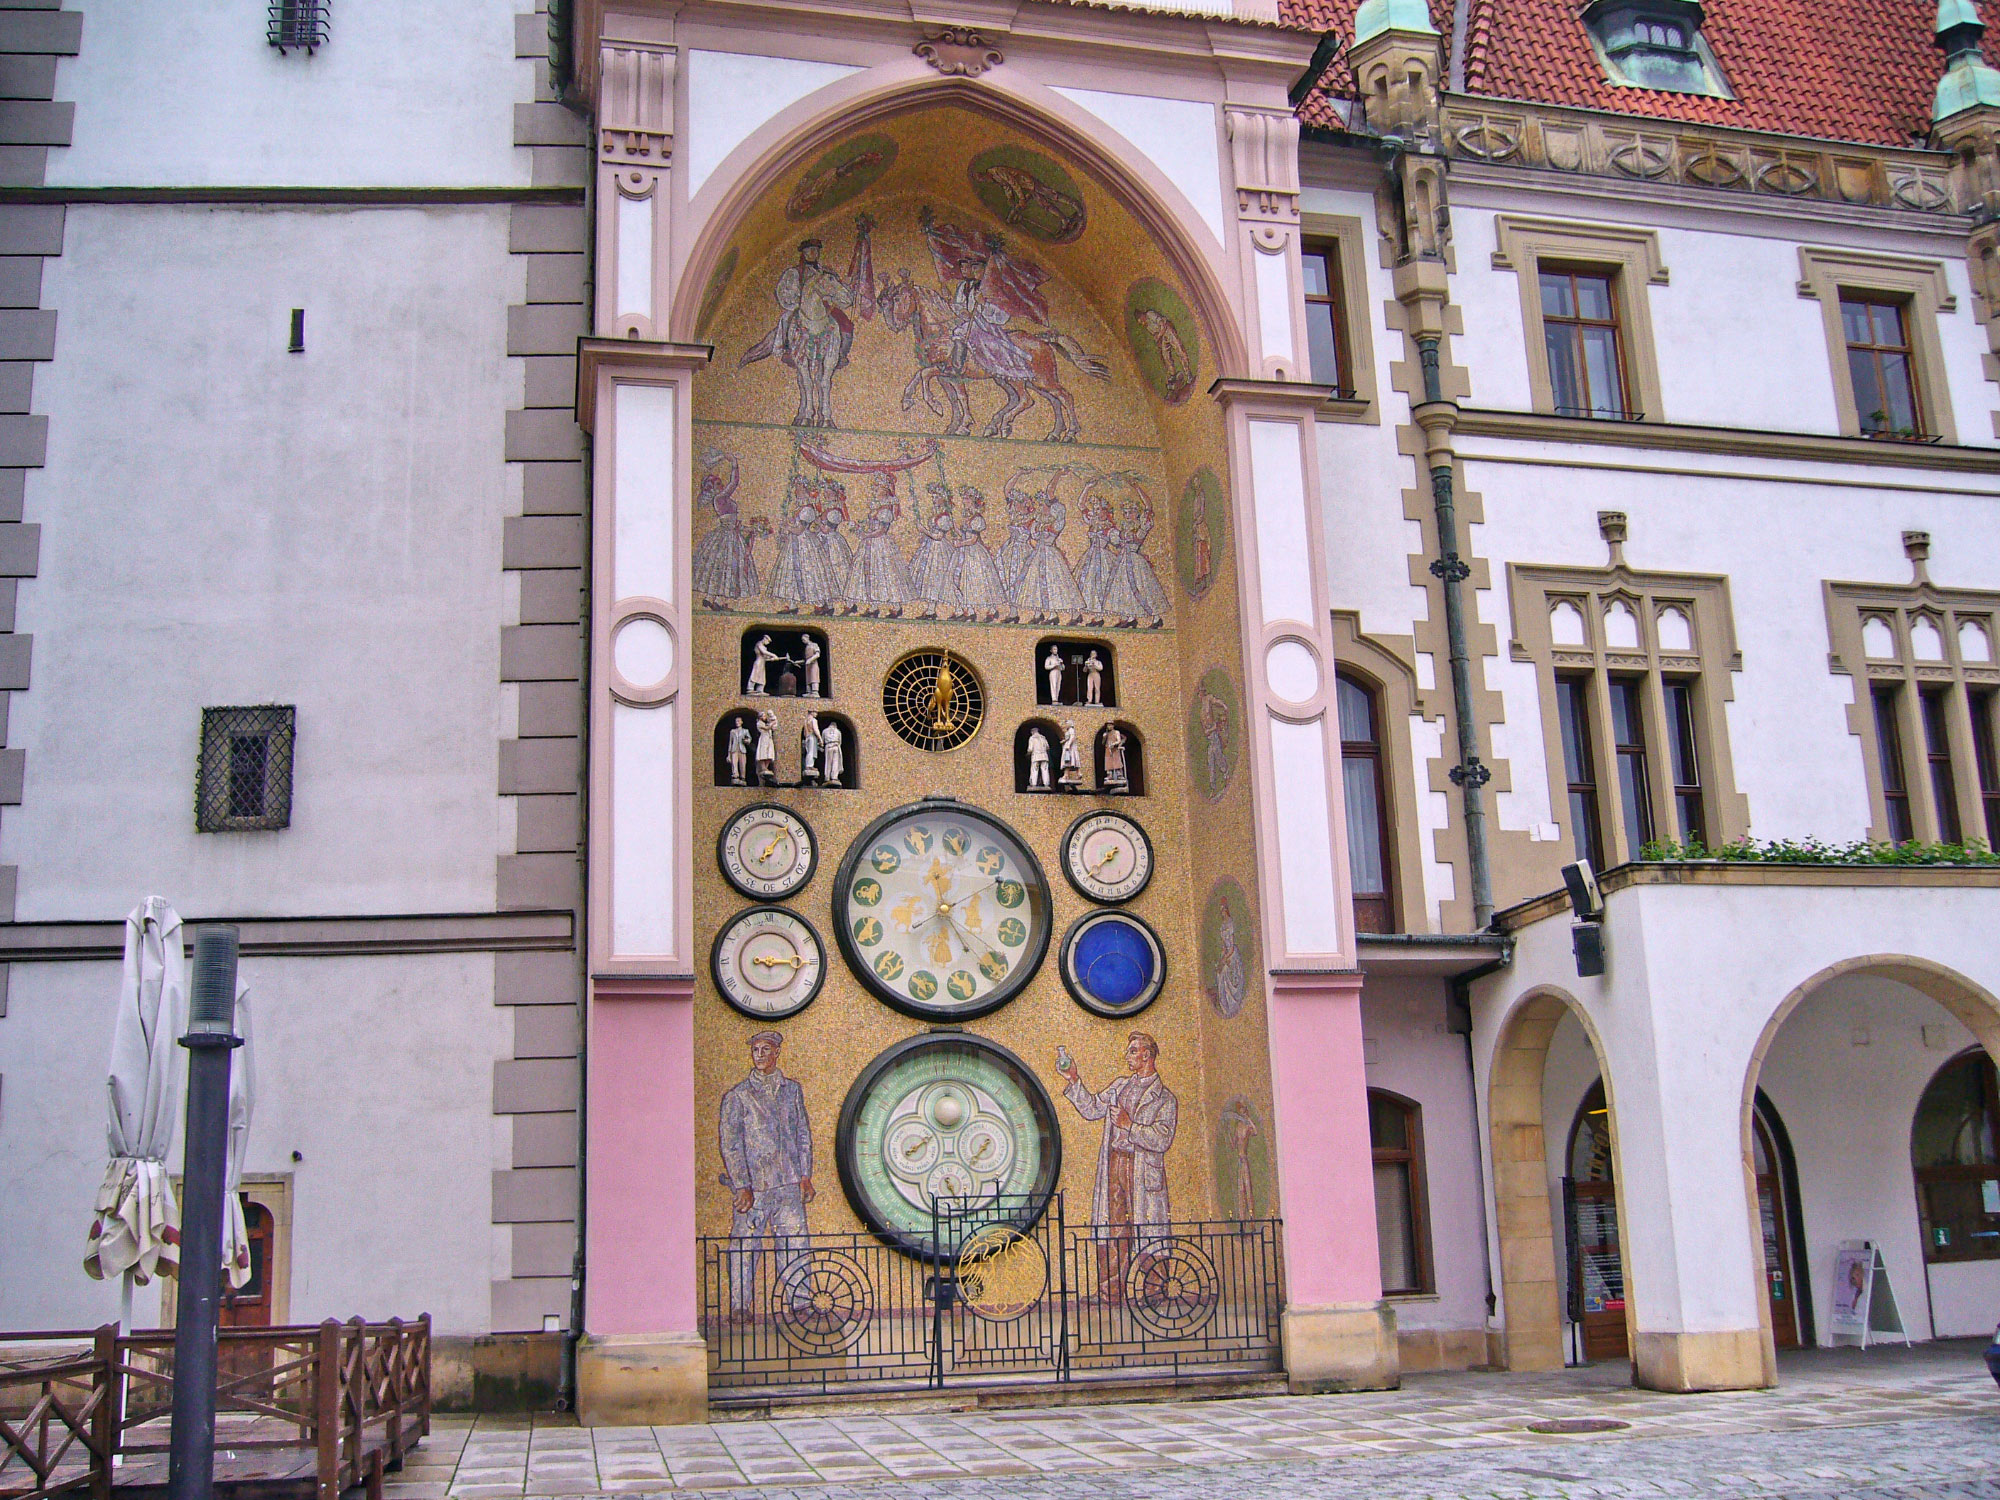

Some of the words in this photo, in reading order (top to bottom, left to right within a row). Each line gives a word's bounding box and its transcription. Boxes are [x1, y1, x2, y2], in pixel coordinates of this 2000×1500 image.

[743, 814, 755, 825] 55
[761, 810, 774, 819] 60
[730, 826, 741, 839] 50
[795, 827, 805, 838] 10
[728, 845, 736, 857] 45
[801, 847, 810, 855] 15
[731, 863, 742, 875] 40
[795, 862, 807, 875] 20
[745, 878, 756, 888] 35
[763, 884, 776, 892] 30
[783, 877, 794, 888] 25
[765, 913, 774, 922] XII
[803, 936, 812, 944] II
